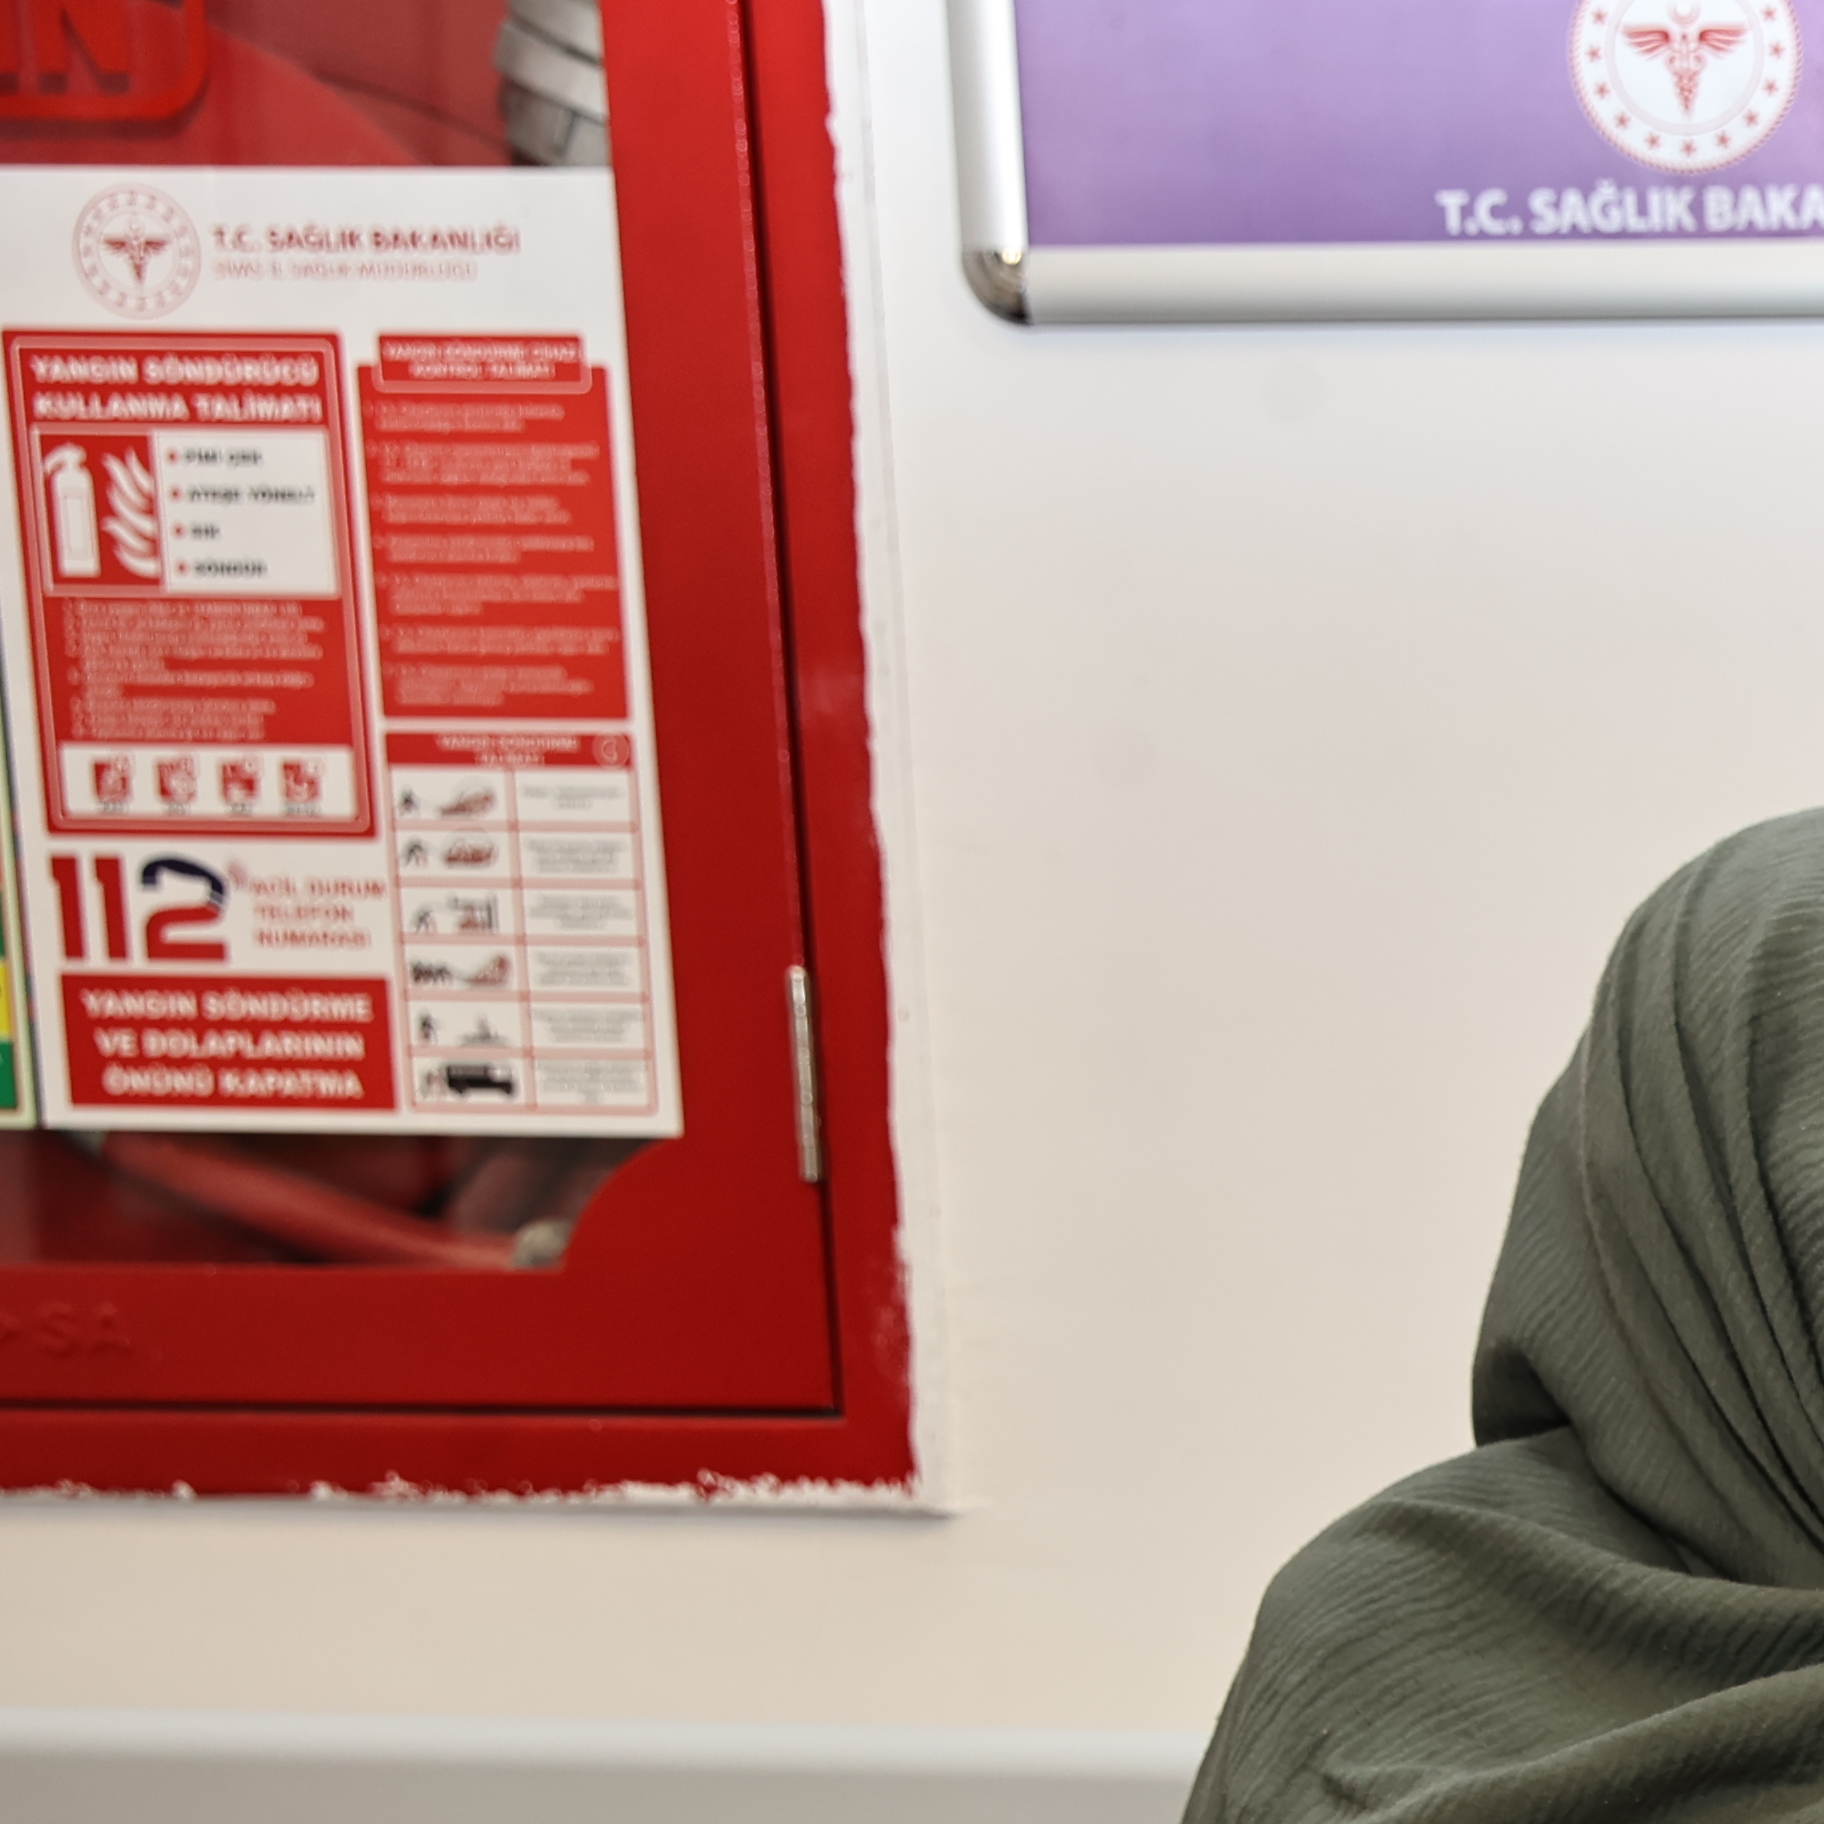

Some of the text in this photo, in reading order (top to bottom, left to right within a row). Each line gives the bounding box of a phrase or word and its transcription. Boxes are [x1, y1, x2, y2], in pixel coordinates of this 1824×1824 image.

[1435, 188, 1524, 236] T.C.
[1529, 178, 1699, 234] SAĞLIK
[212, 220, 521, 252] T.C. SAĞLIK BAKANLIĞI
[31, 351, 320, 385] YANGIN SÖNDÜRÜCÜ
[33, 388, 323, 422] KULLANMA TALİMATI
[306, 877, 387, 899] DURUM
[49, 856, 228, 961] 112
[81, 985, 375, 1023] YANGIN SÖNDÜRME
[93, 1026, 366, 1061] VE DOLAPLARININ
[102, 1060, 365, 1099] ÖNÜNÜ KAPATMA
